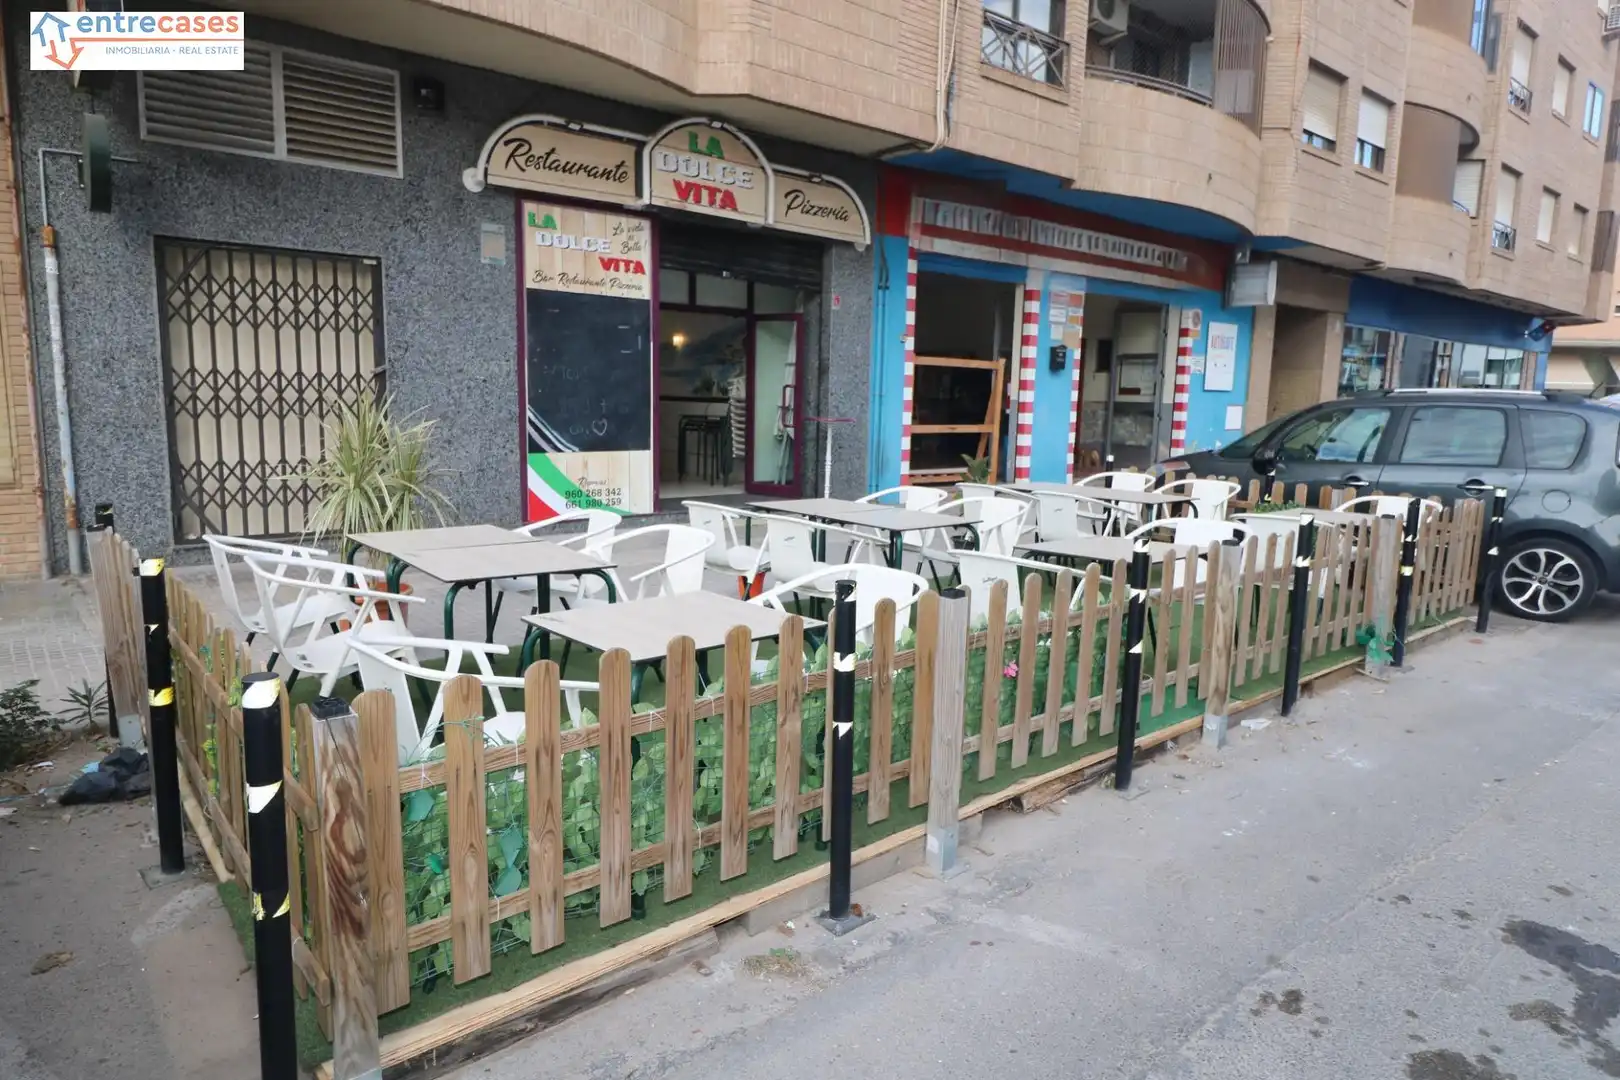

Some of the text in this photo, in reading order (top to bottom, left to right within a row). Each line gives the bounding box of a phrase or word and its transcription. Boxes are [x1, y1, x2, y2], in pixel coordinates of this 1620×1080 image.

[687, 131, 725, 159] LA
[503, 137, 629, 184] Restaurante
[655, 151, 754, 189] DOLCE
[672, 179, 739, 212] VITA
[784, 189, 849, 223] Pizzeria
[527, 210, 557, 230] LA
[535, 231, 612, 253] DOLCE
[532, 269, 554, 284] Bar
[598, 256, 646, 275] VITA
[564, 487, 622, 499] 960 268 342
[585, 499, 603, 508] 980
[605, 497, 622, 507] 259
